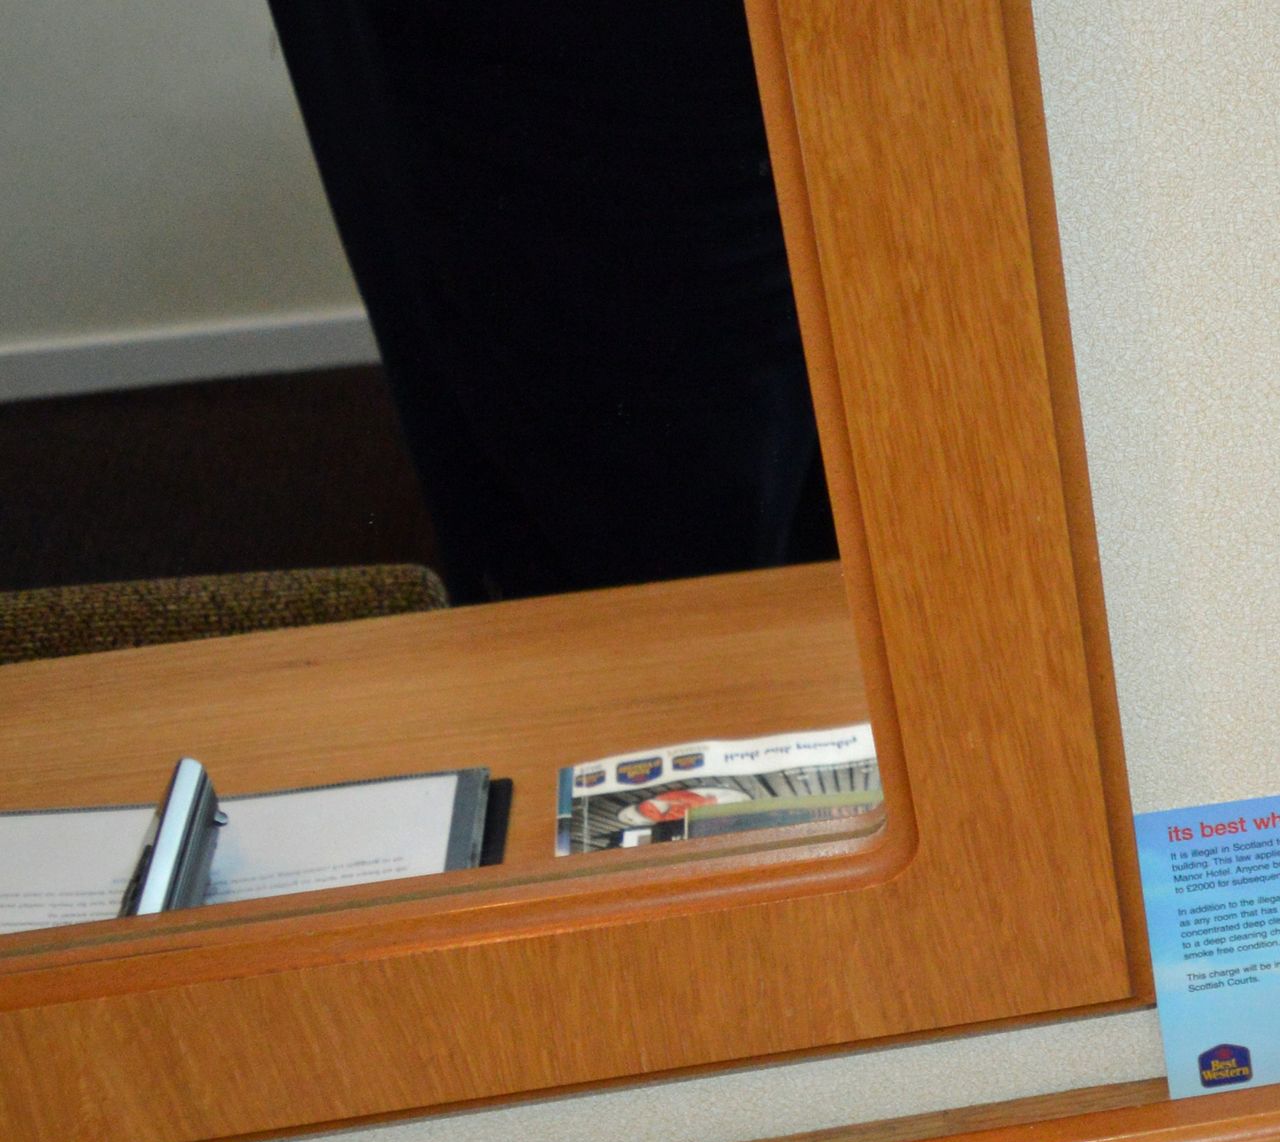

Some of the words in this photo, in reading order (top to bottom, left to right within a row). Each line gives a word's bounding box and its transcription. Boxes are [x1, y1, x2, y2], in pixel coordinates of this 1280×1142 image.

[1168, 826, 1193, 841] its
[1199, 818, 1246, 838] best
[1169, 852, 1177, 861] It
[1179, 851, 1188, 859] is
[1190, 845, 1218, 857] illegal
[1220, 843, 1230, 853] in
[1232, 838, 1273, 852] Scotland
[1201, 1063, 1251, 1084] Western
[1209, 1056, 1237, 1071] Best
